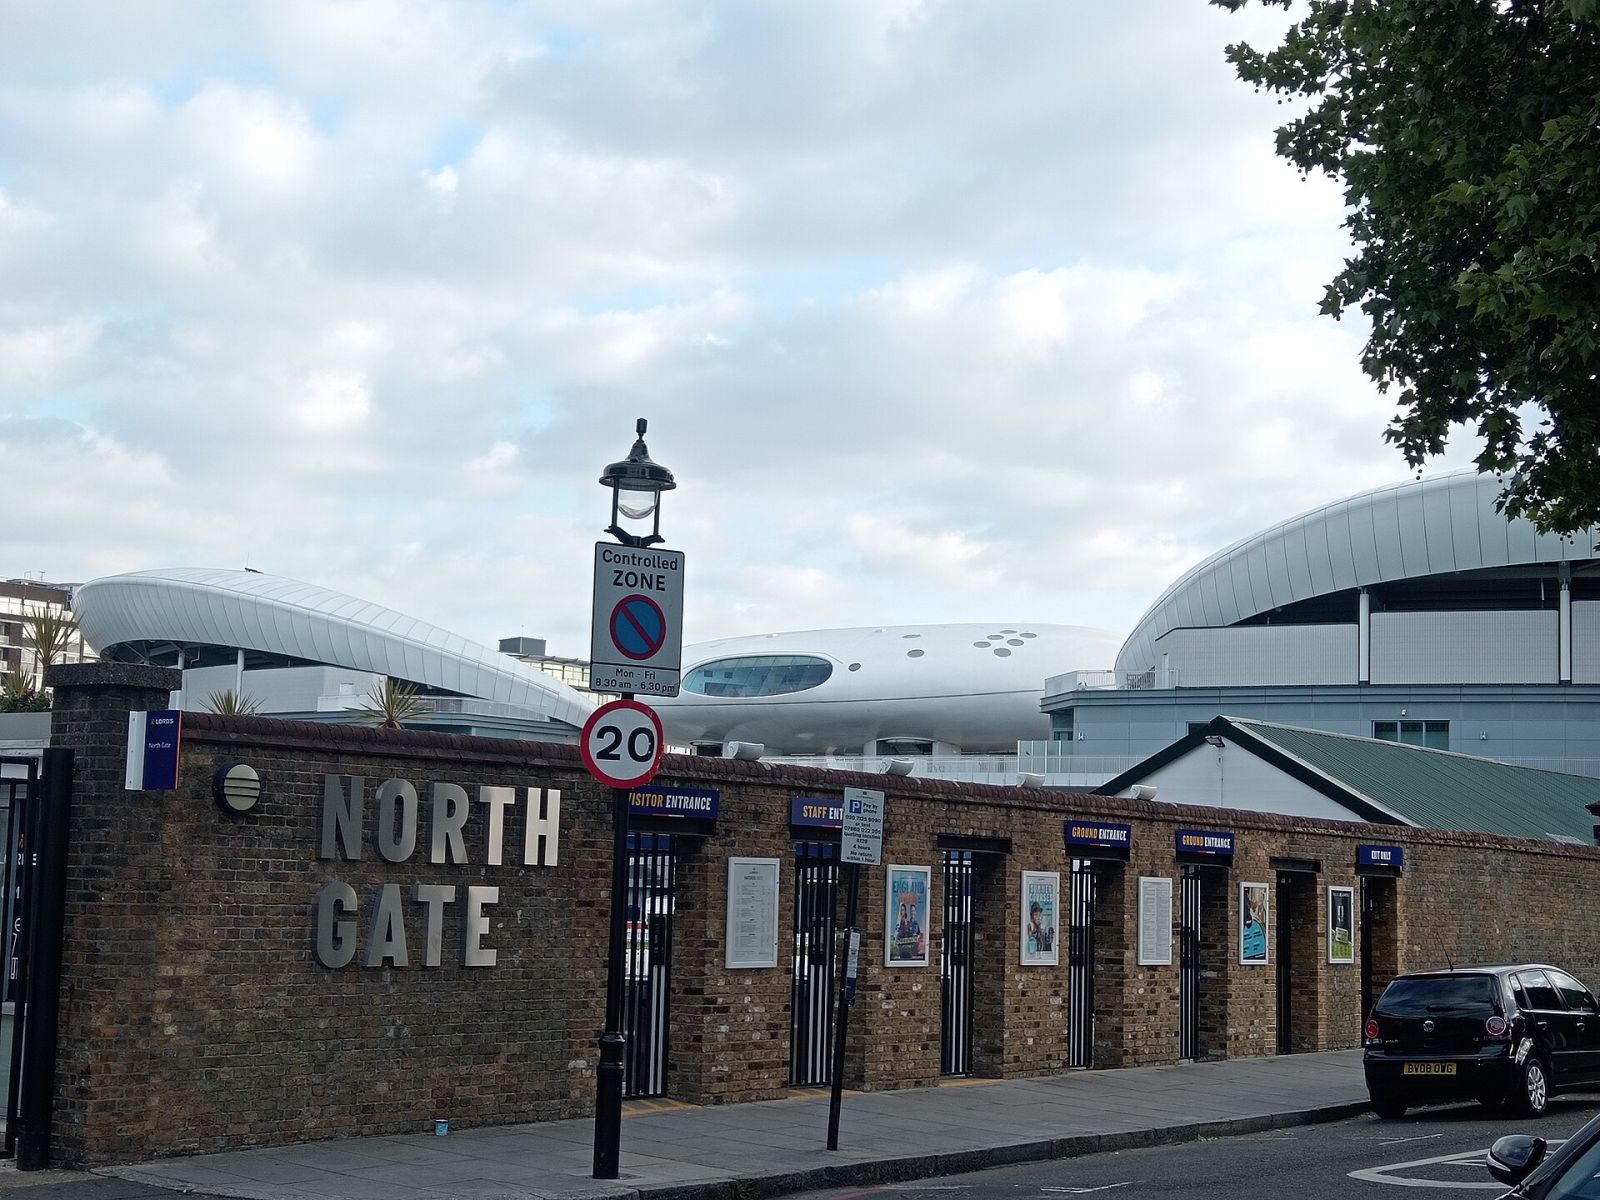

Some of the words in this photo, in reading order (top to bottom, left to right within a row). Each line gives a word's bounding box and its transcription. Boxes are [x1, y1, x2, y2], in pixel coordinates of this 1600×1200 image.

[602, 549, 678, 570] Controlled
[613, 570, 667, 592] ZONE
[615, 668, 634, 678] Mon
[644, 671, 656, 680] Fri
[595, 678, 617, 688] 8.30
[619, 681, 632, 689] am
[640, 681, 661, 691] 6.30
[662, 684, 675, 692] pm
[596, 725, 655, 763] 20
[665, 795, 712, 811] ENTRANCE
[803, 805, 828, 819] STAFF
[318, 775, 561, 867] NORTH
[1072, 826, 1098, 839] GROUND
[1098, 828, 1127, 841] ENTRANCE
[1183, 835, 1204, 846] GROUND
[1204, 837, 1231, 849] ENTRANCE
[892, 881, 925, 895] ENGLAND
[316, 882, 499, 968] GATE
